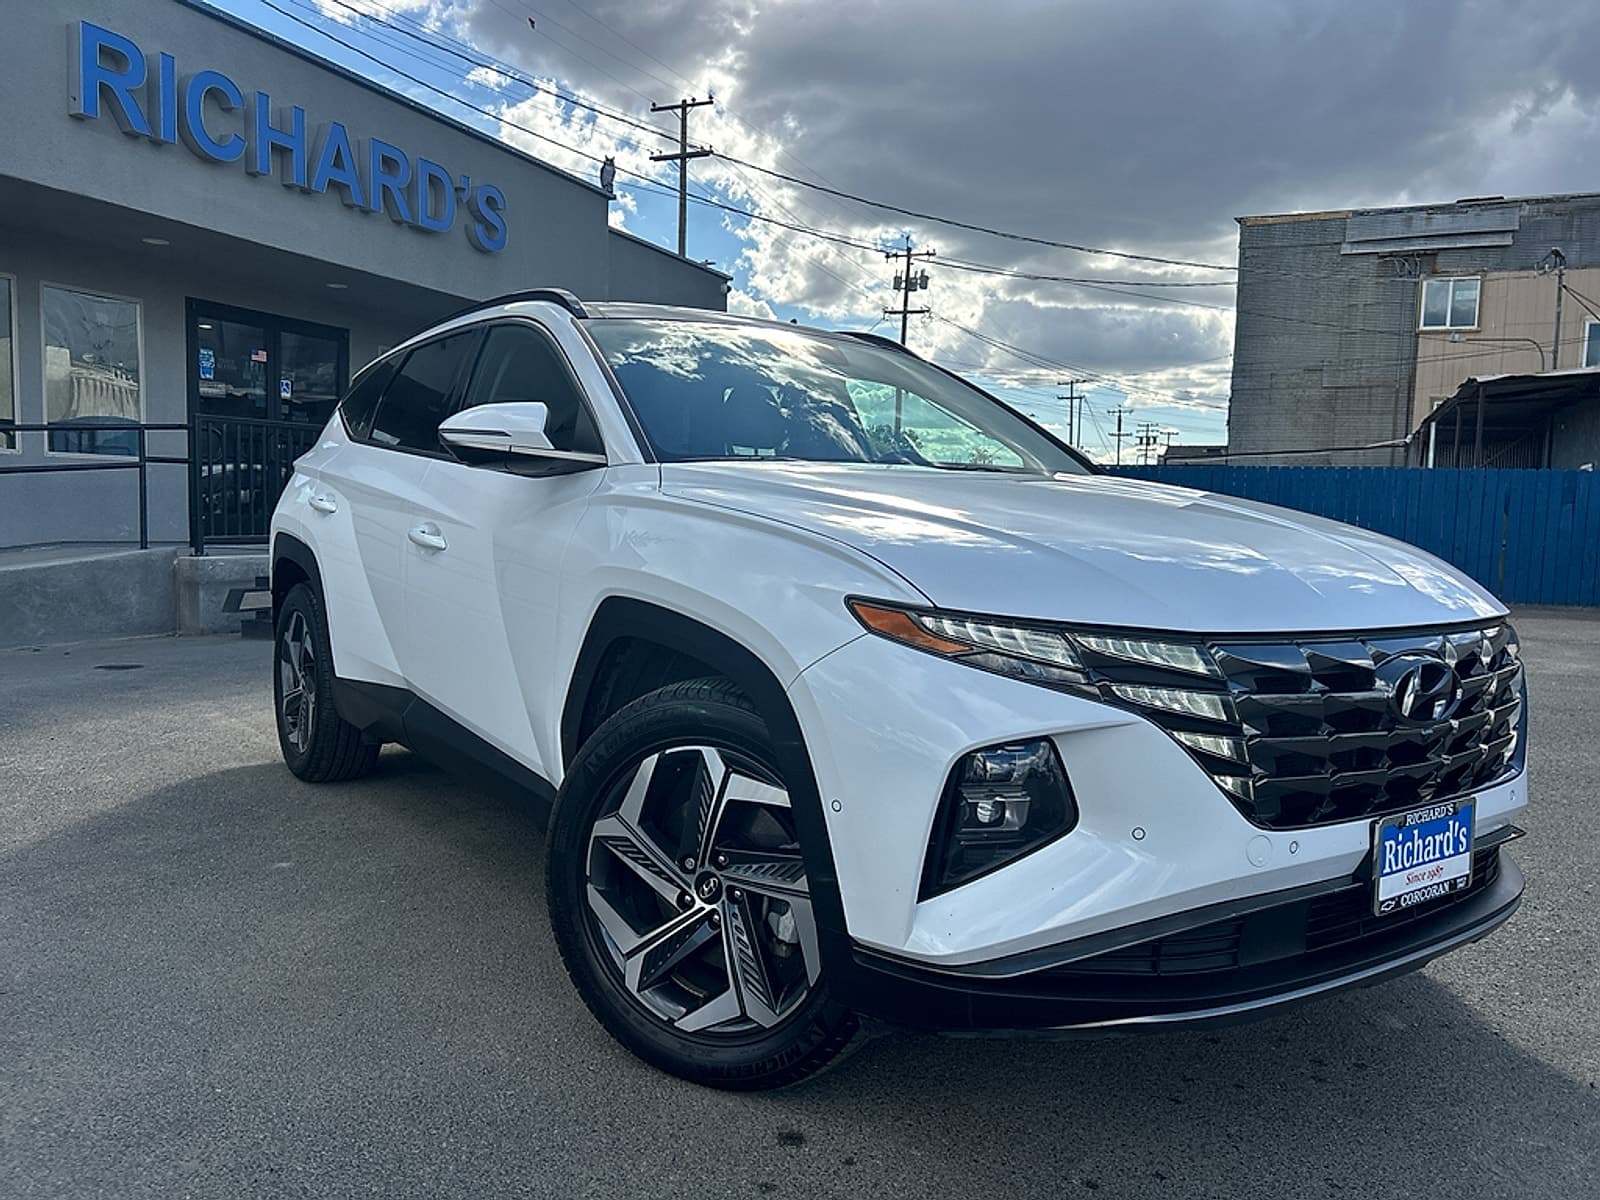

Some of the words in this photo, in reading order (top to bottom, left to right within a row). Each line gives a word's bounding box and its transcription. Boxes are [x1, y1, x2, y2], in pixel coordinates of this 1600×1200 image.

[74, 20, 508, 252] RICHARD'S
[1406, 804, 1454, 826] RICHARD'S
[1382, 820, 1467, 874] Richard's
[1406, 870, 1427, 885] Since
[1400, 881, 1450, 906] CORCORAN
